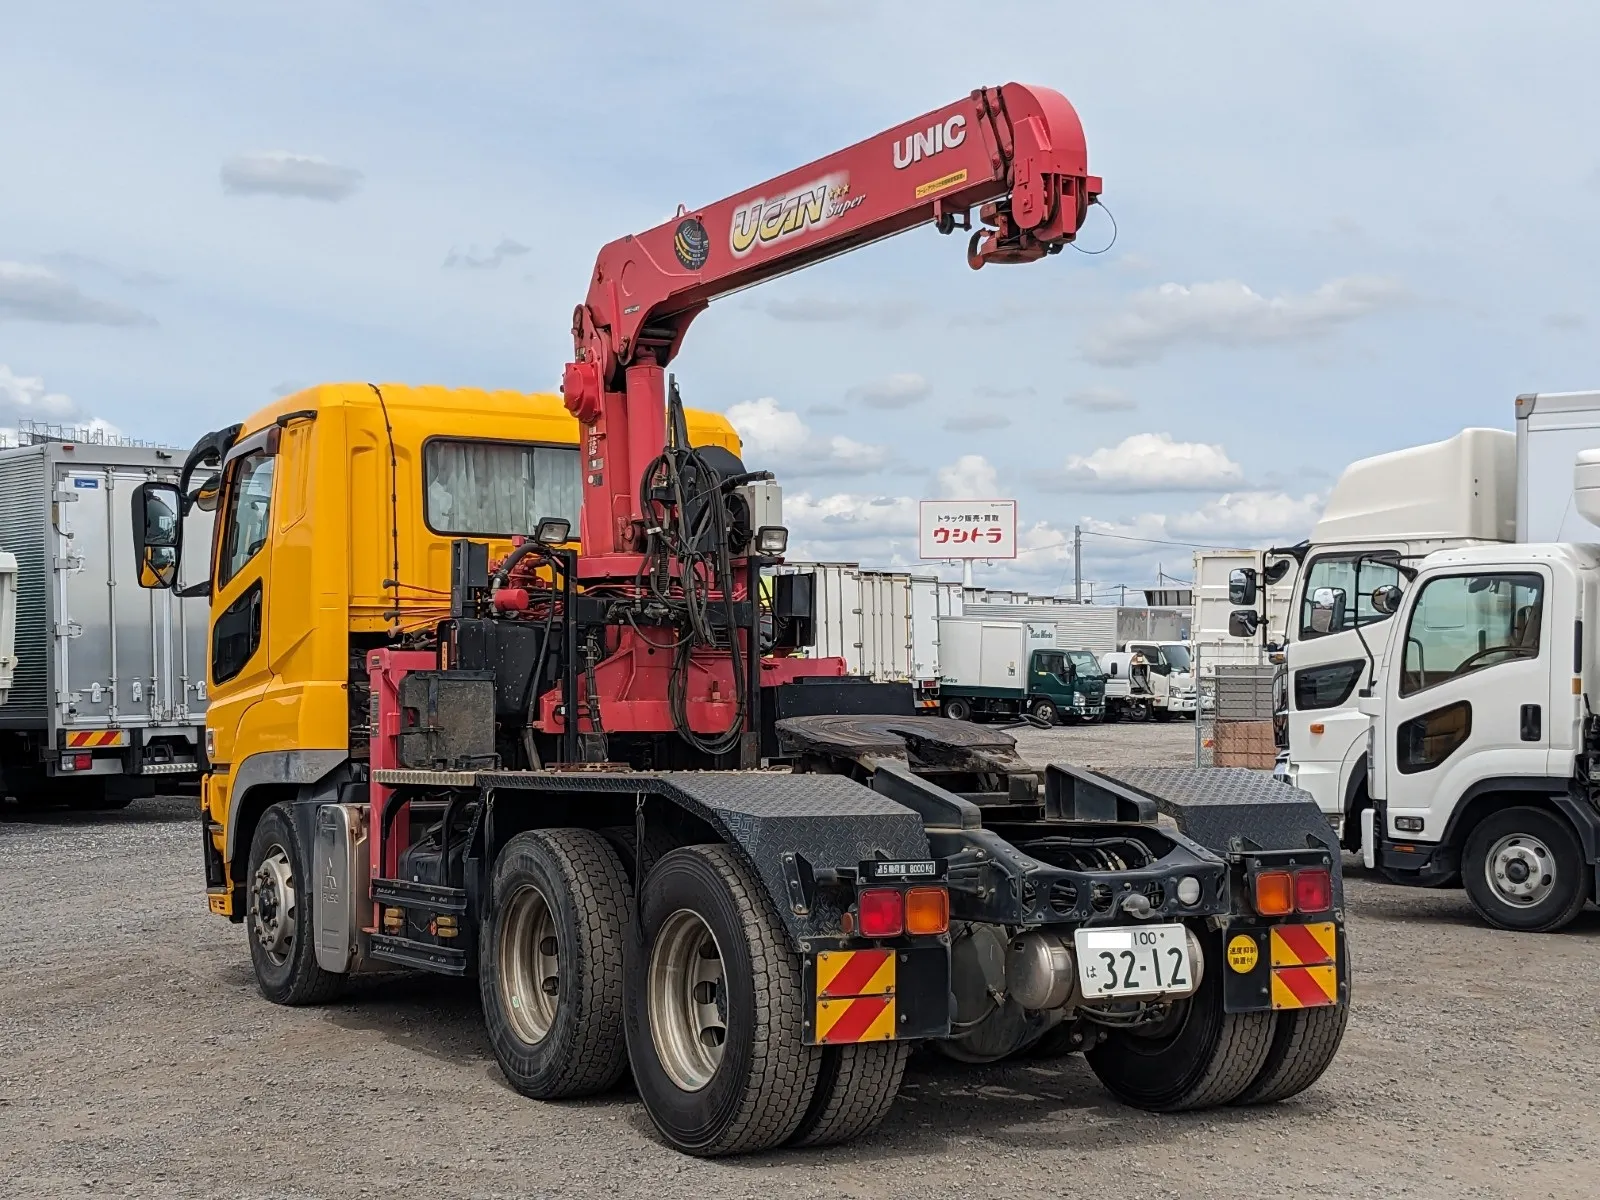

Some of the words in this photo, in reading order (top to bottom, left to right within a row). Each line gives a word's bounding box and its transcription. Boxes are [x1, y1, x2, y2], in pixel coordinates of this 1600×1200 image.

[893, 114, 967, 169] UNIC
[826, 194, 867, 218] Super
[732, 185, 828, 252] UCAN
[937, 514, 999, 523] トラック販売・買取
[933, 527, 1002, 544] ウシトラ
[1133, 931, 1157, 945] 100
[1086, 966, 1097, 978] は
[1098, 947, 1187, 990] 32-12
